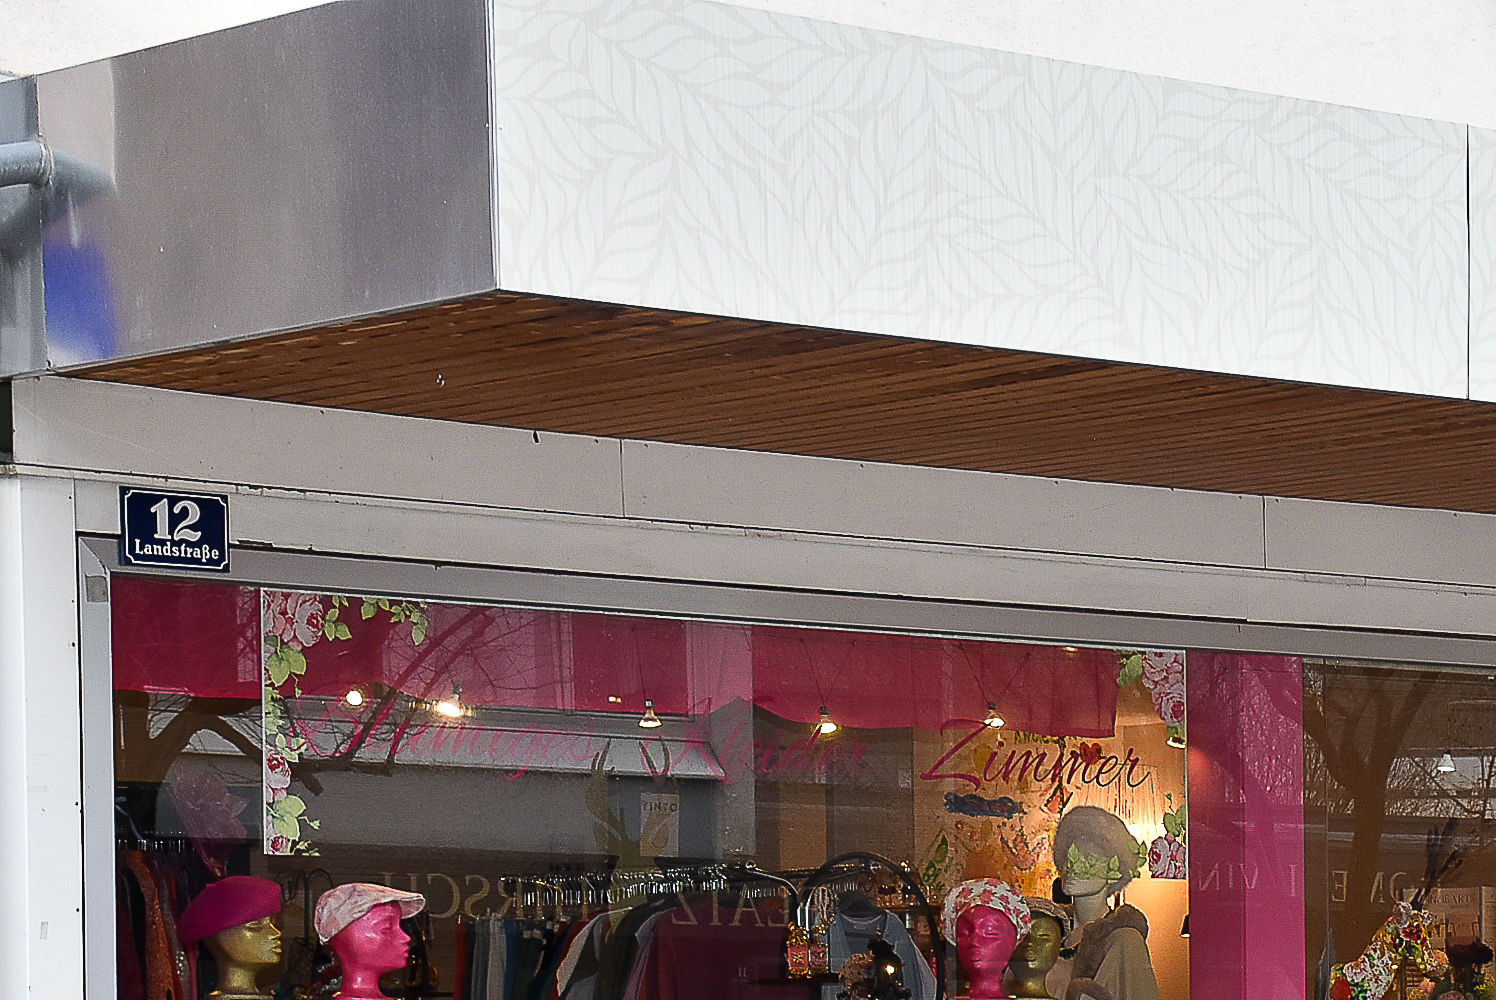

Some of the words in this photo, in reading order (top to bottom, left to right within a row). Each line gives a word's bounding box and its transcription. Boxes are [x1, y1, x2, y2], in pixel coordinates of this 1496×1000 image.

[150, 497, 202, 542] 12
[134, 538, 220, 563] Landstraße
[919, 717, 1150, 792] Zimmer
